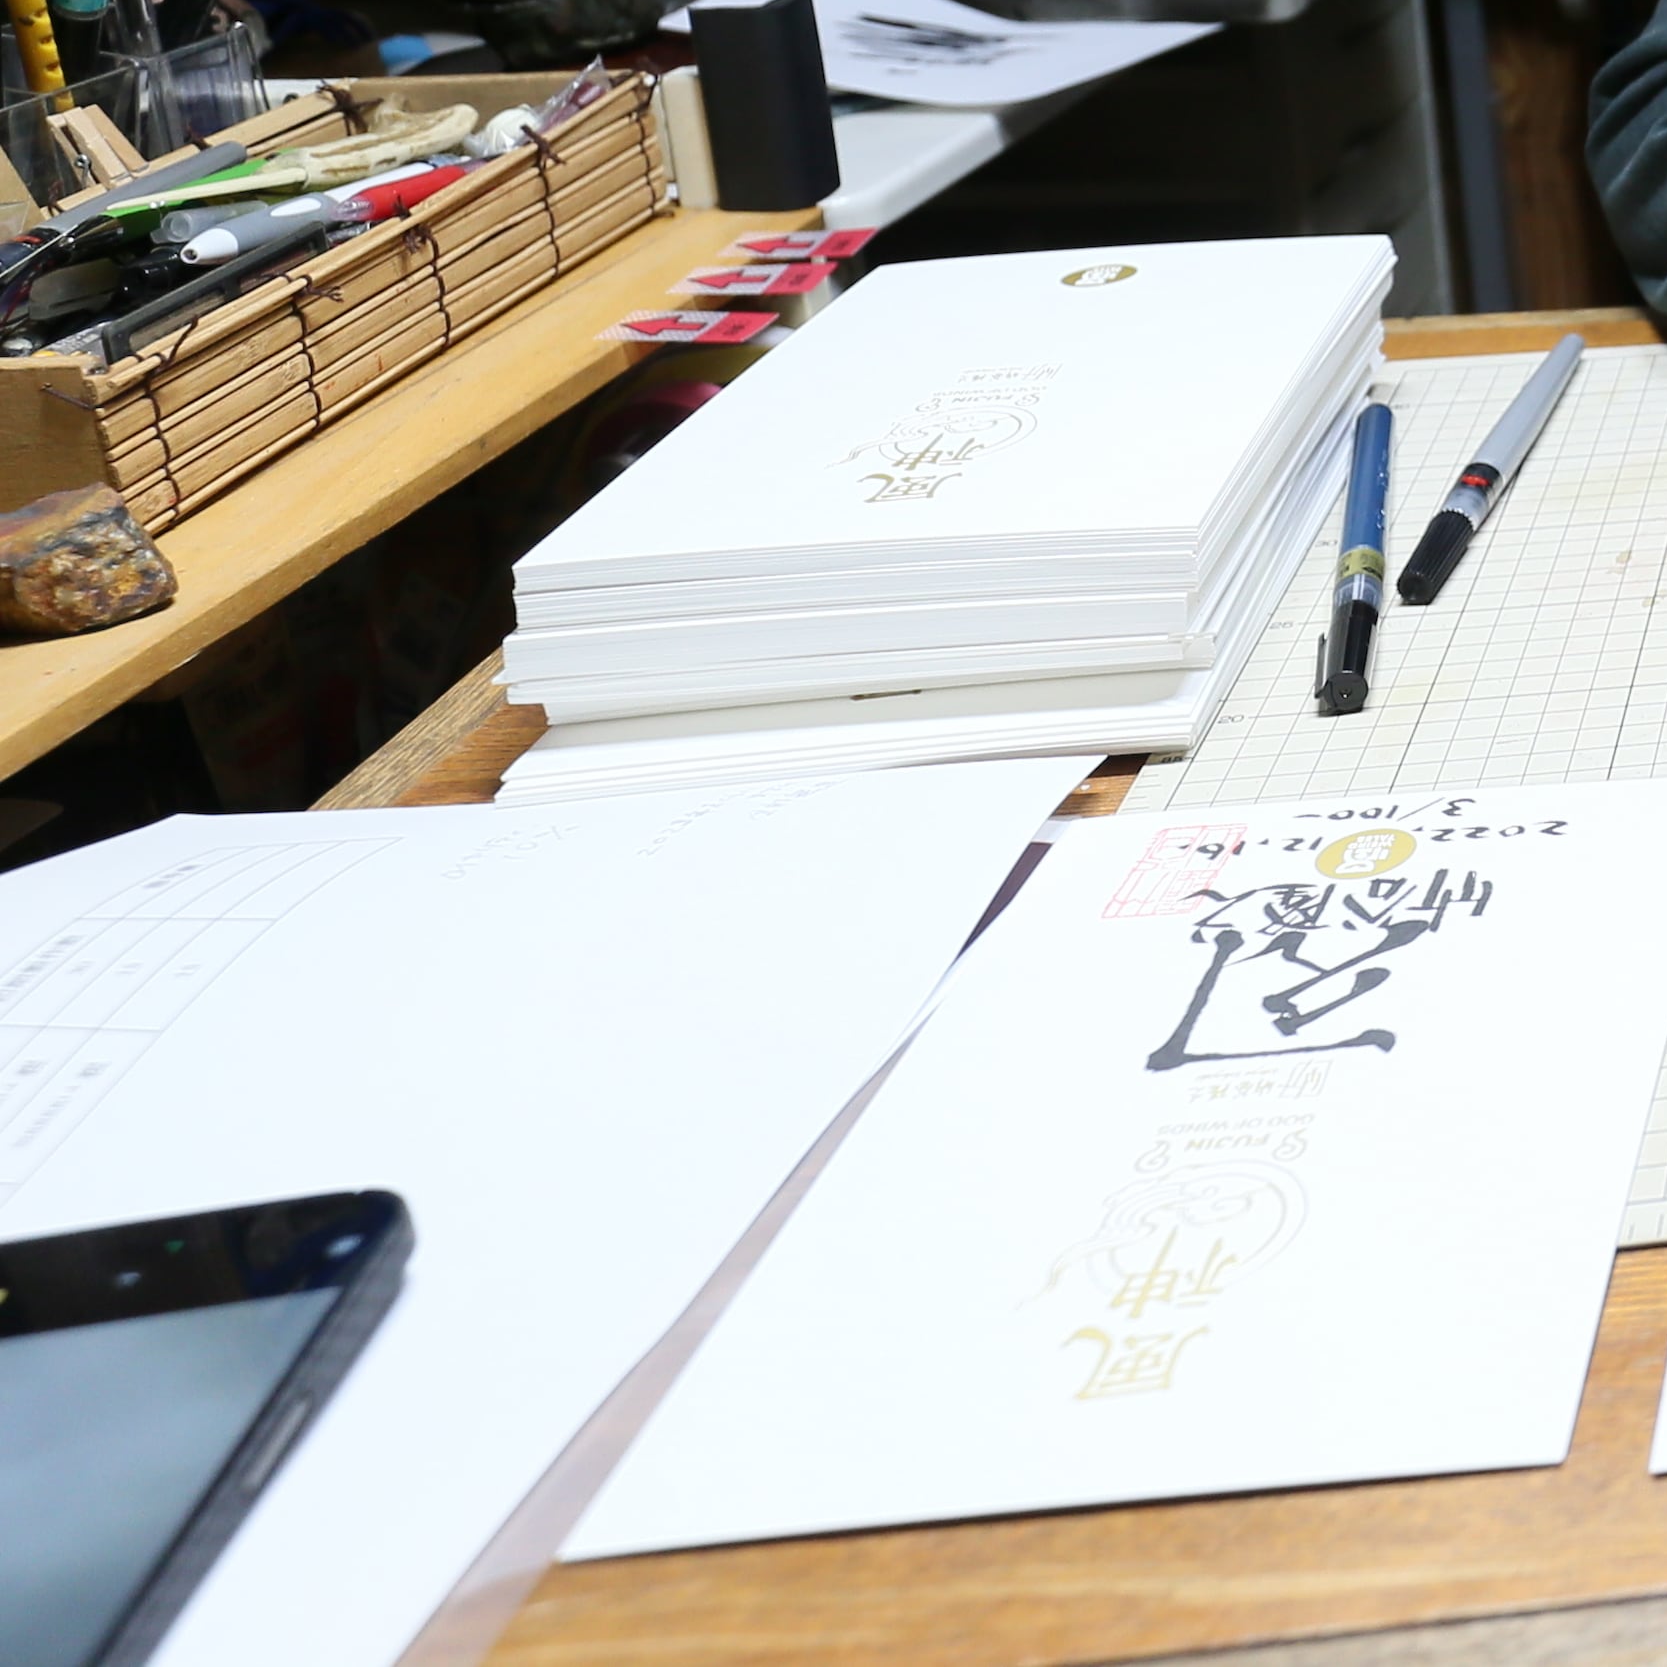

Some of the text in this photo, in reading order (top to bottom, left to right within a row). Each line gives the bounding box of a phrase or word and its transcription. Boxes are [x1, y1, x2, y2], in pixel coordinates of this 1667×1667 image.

[1217, 713, 1245, 724] 20
[1267, 1113, 1317, 1129] GOD
[1184, 1131, 1271, 1152] FUJIN
